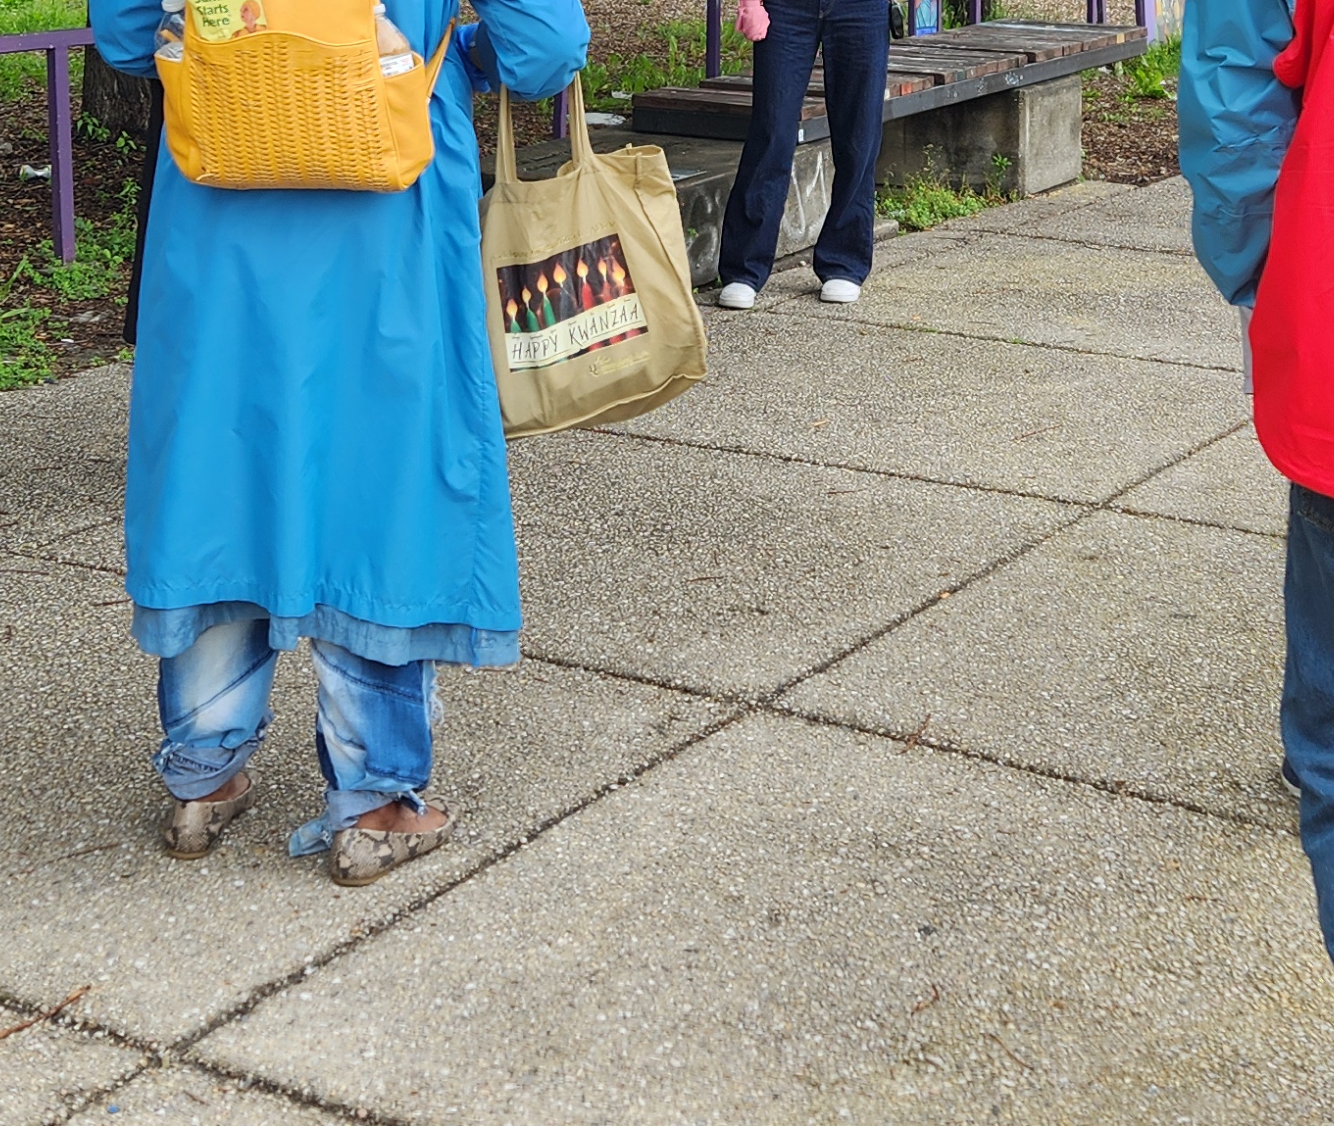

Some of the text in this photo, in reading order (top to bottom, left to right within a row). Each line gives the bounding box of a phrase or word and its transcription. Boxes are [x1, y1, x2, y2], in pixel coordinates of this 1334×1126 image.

[196, 3, 229, 16] Starts
[202, 17, 230, 28] Here
[512, 303, 639, 360] HAPPY KWANZAA
